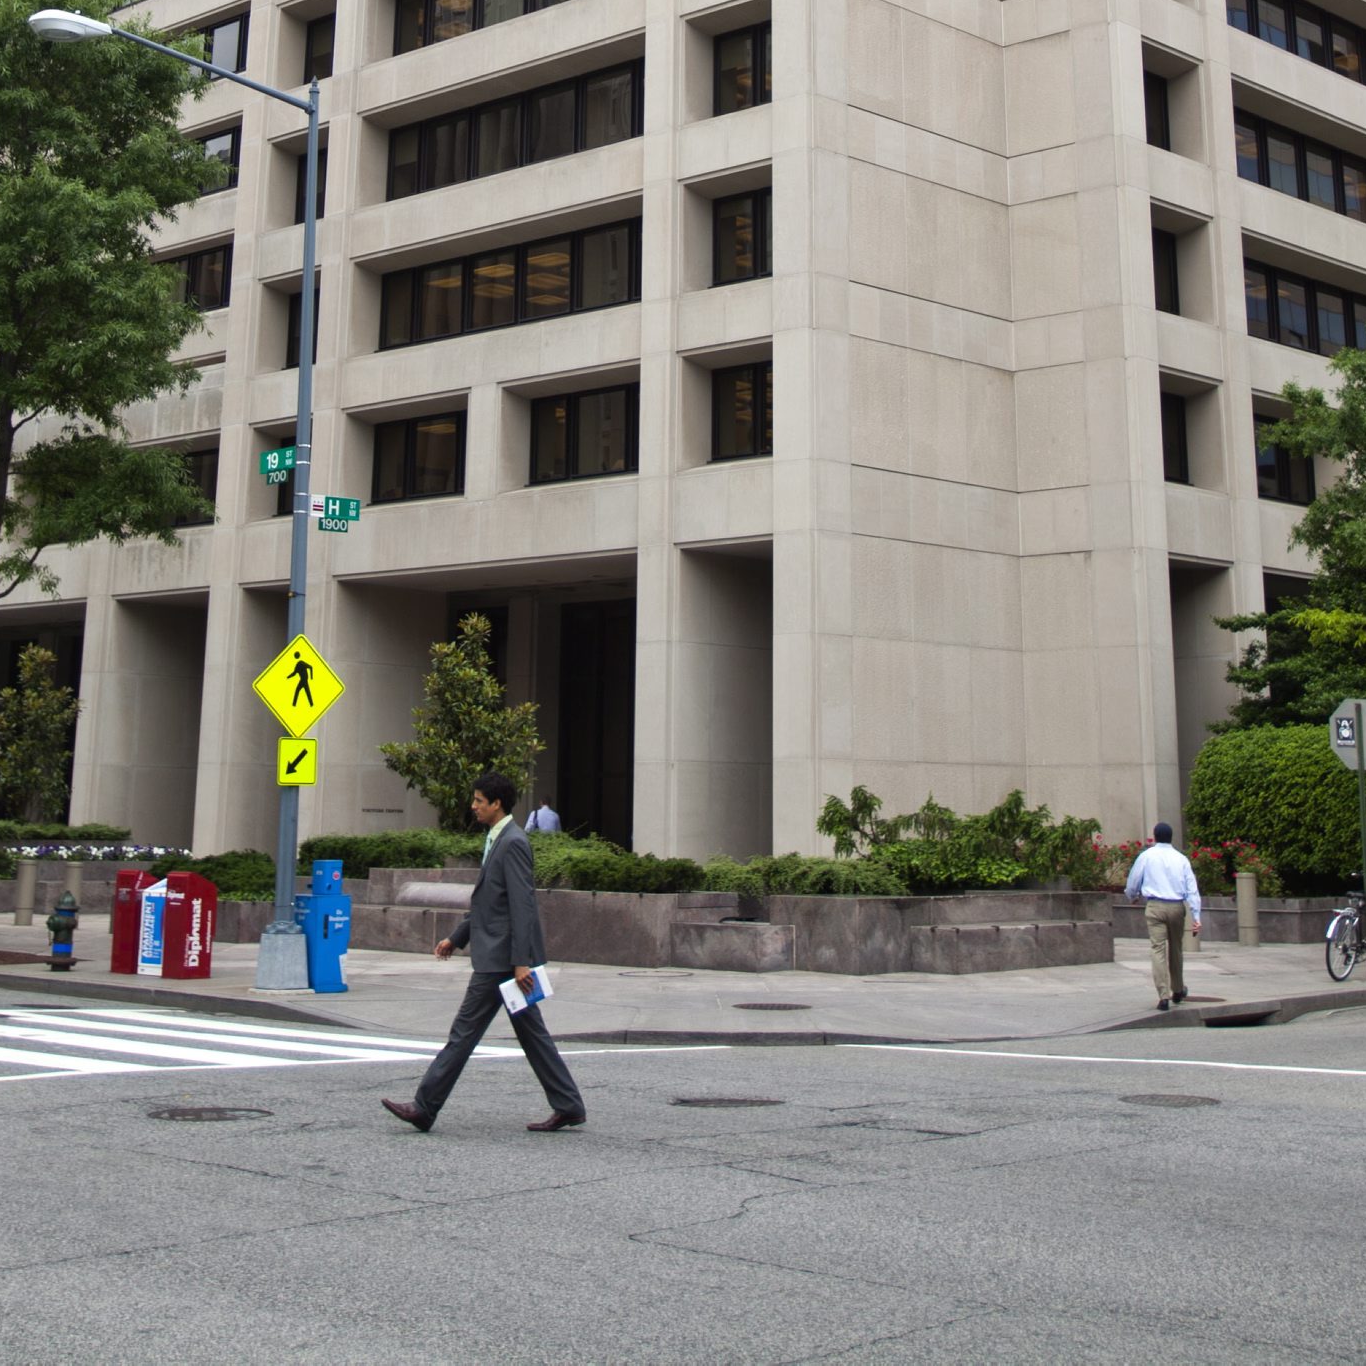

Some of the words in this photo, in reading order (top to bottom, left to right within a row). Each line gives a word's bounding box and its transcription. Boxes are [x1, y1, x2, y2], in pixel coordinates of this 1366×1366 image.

[267, 452, 278, 469] 19
[268, 470, 287, 483] 700
[328, 499, 340, 515] H
[321, 518, 347, 531] 1900
[189, 898, 202, 967] Diplomat
